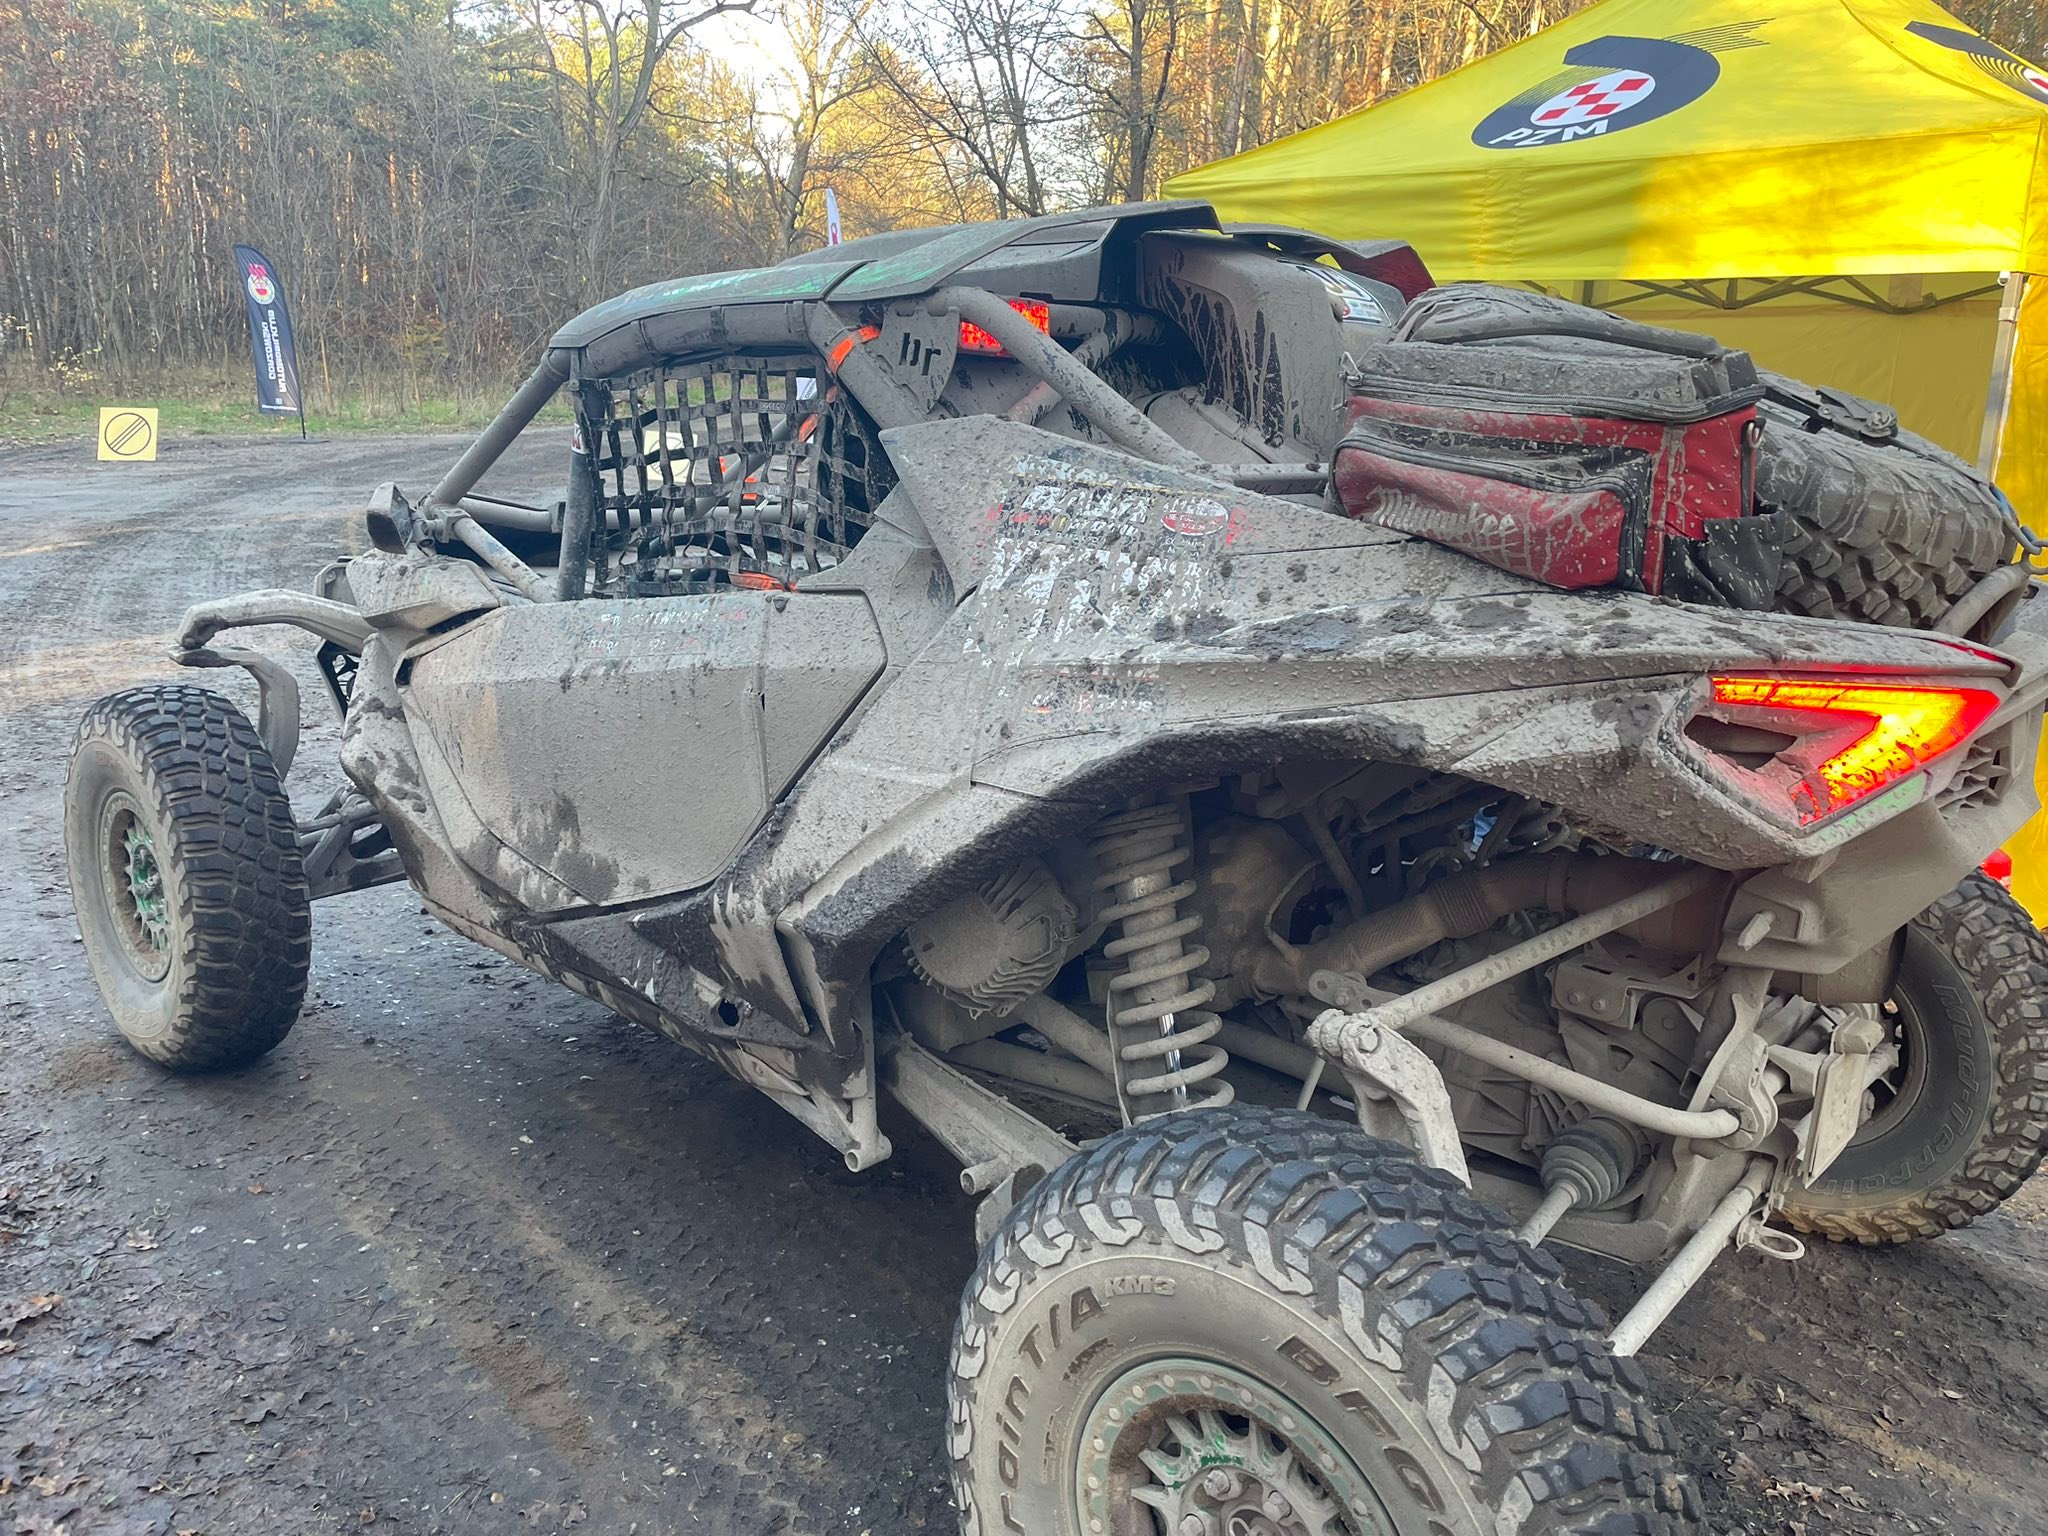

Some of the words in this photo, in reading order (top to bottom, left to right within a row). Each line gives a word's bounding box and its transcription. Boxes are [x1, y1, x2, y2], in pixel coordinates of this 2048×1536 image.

[1487, 118, 1609, 147] PZM
[1808, 984, 1981, 1196] Mud-Terrain
[1017, 1286, 1105, 1370] T/A
[1104, 1275, 1177, 1297] KM3
